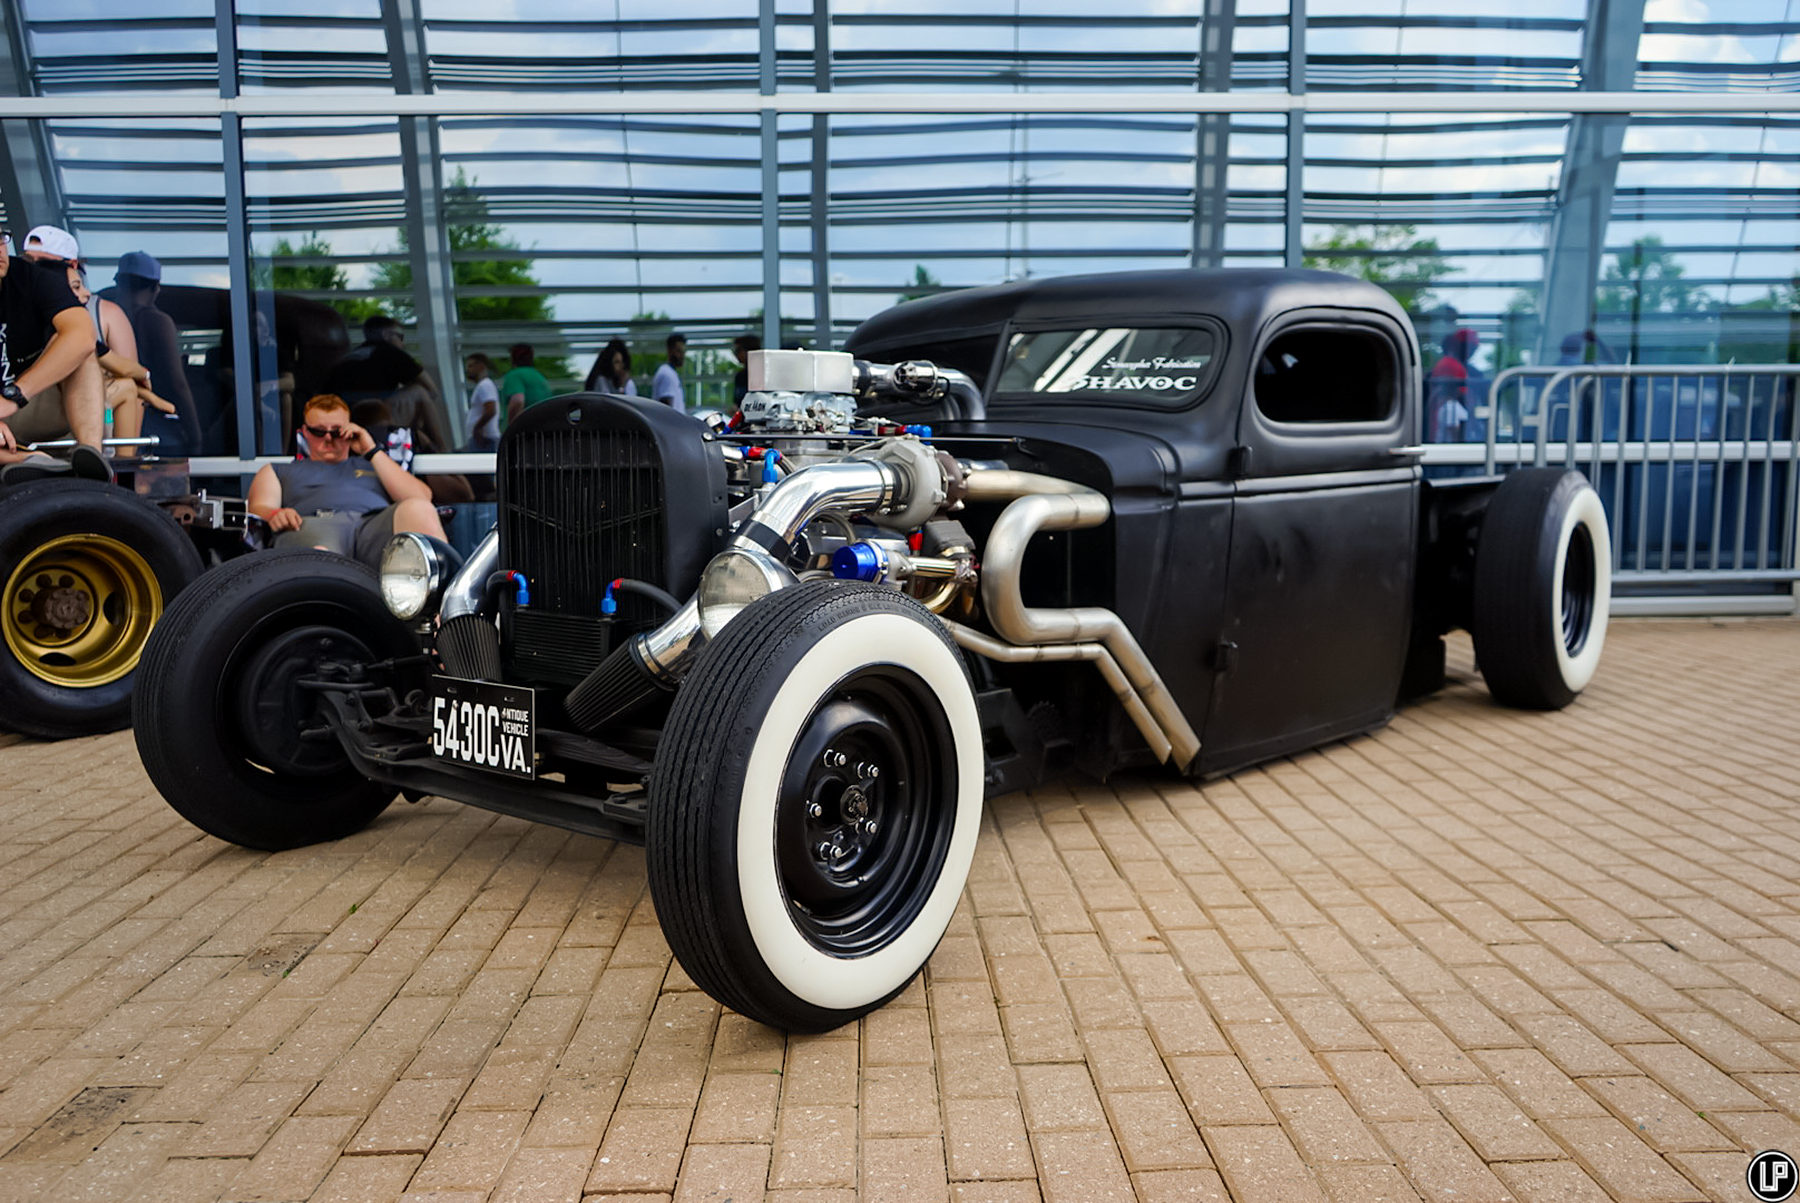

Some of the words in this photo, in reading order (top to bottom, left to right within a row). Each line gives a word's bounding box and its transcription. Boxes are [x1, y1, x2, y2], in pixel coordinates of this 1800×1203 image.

[502, 707, 530, 723] ANTIQUE
[433, 697, 500, 767] 5430C
[502, 721, 529, 737] VEHICLE
